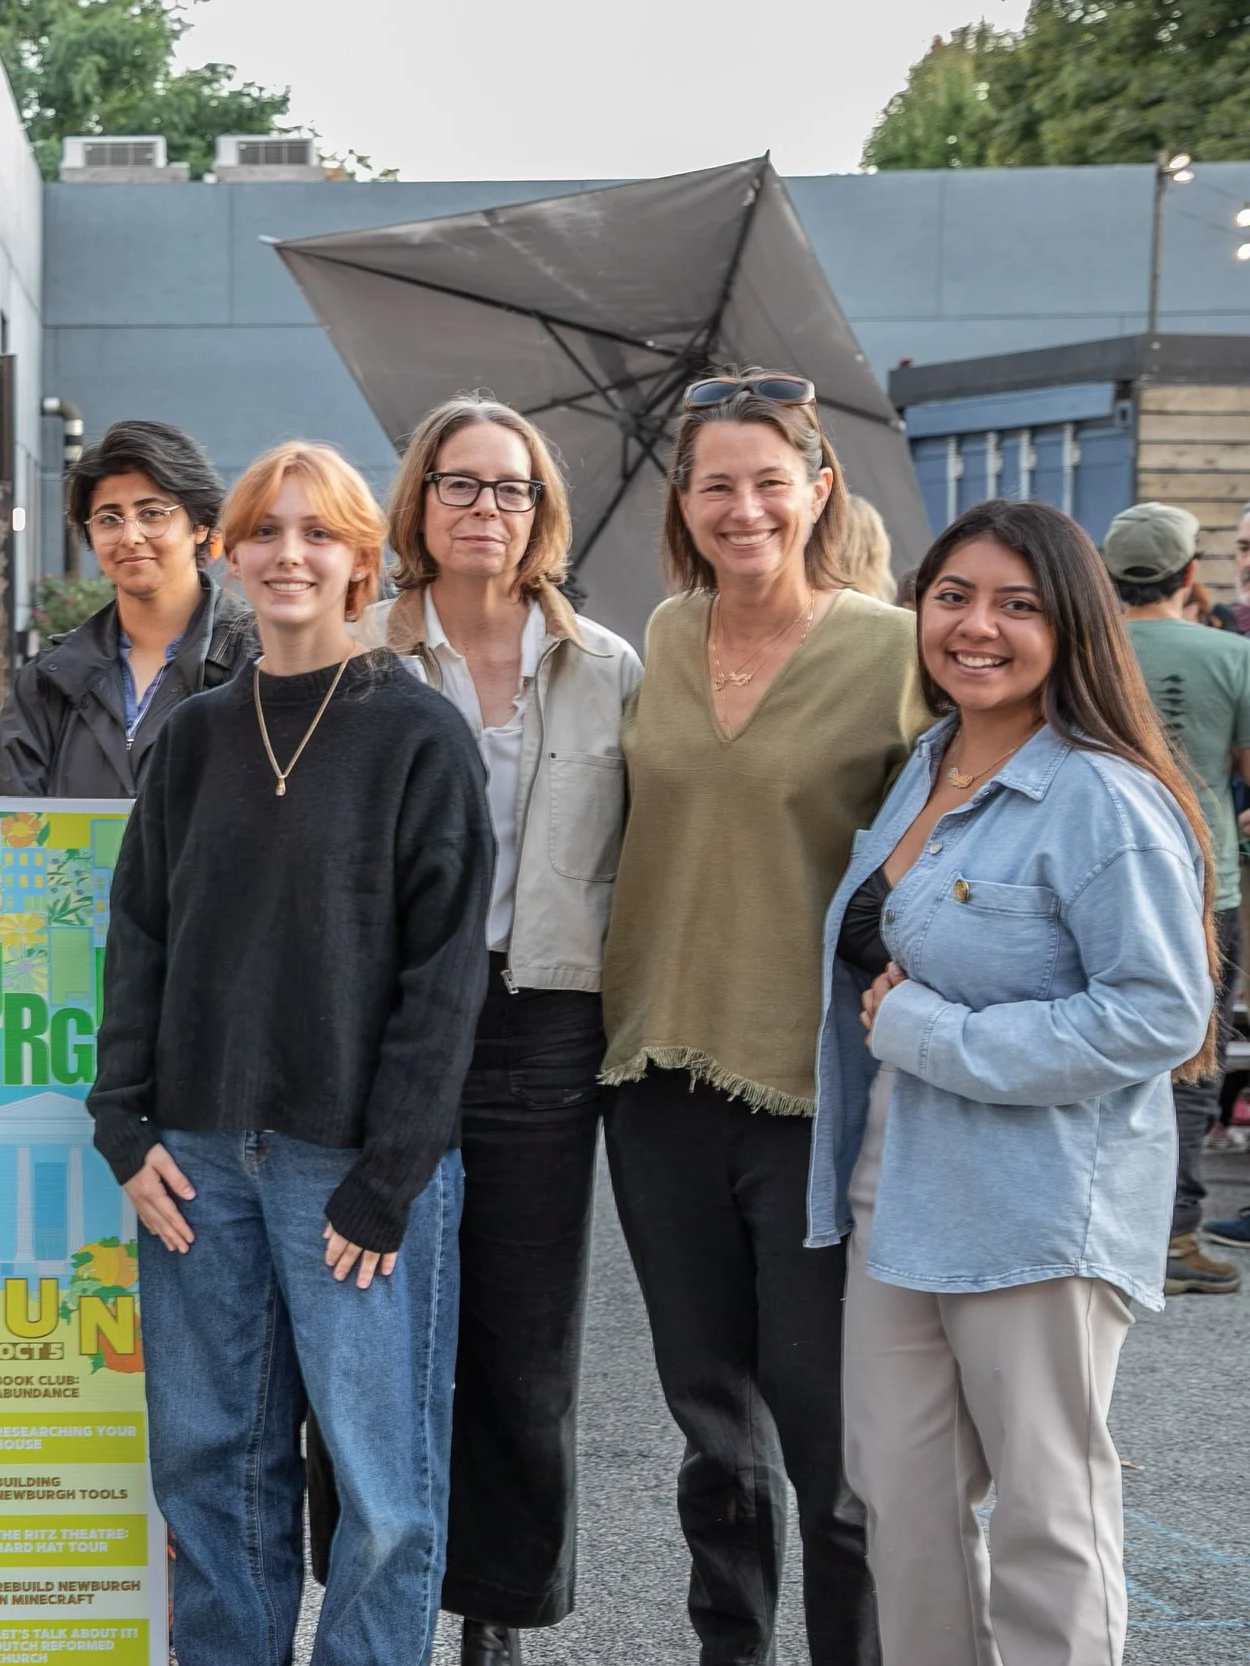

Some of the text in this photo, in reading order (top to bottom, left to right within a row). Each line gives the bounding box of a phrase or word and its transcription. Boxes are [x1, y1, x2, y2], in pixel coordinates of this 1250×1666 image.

[50, 1343, 63, 1359] 5
[39, 1376, 79, 1386] CLUB:
[96, 1426, 136, 1437] YOUR
[80, 1489, 128, 1499] TOOLS
[58, 1581, 141, 1591] NEWBURGH
[11, 1594, 94, 1605] MINECRAFT
